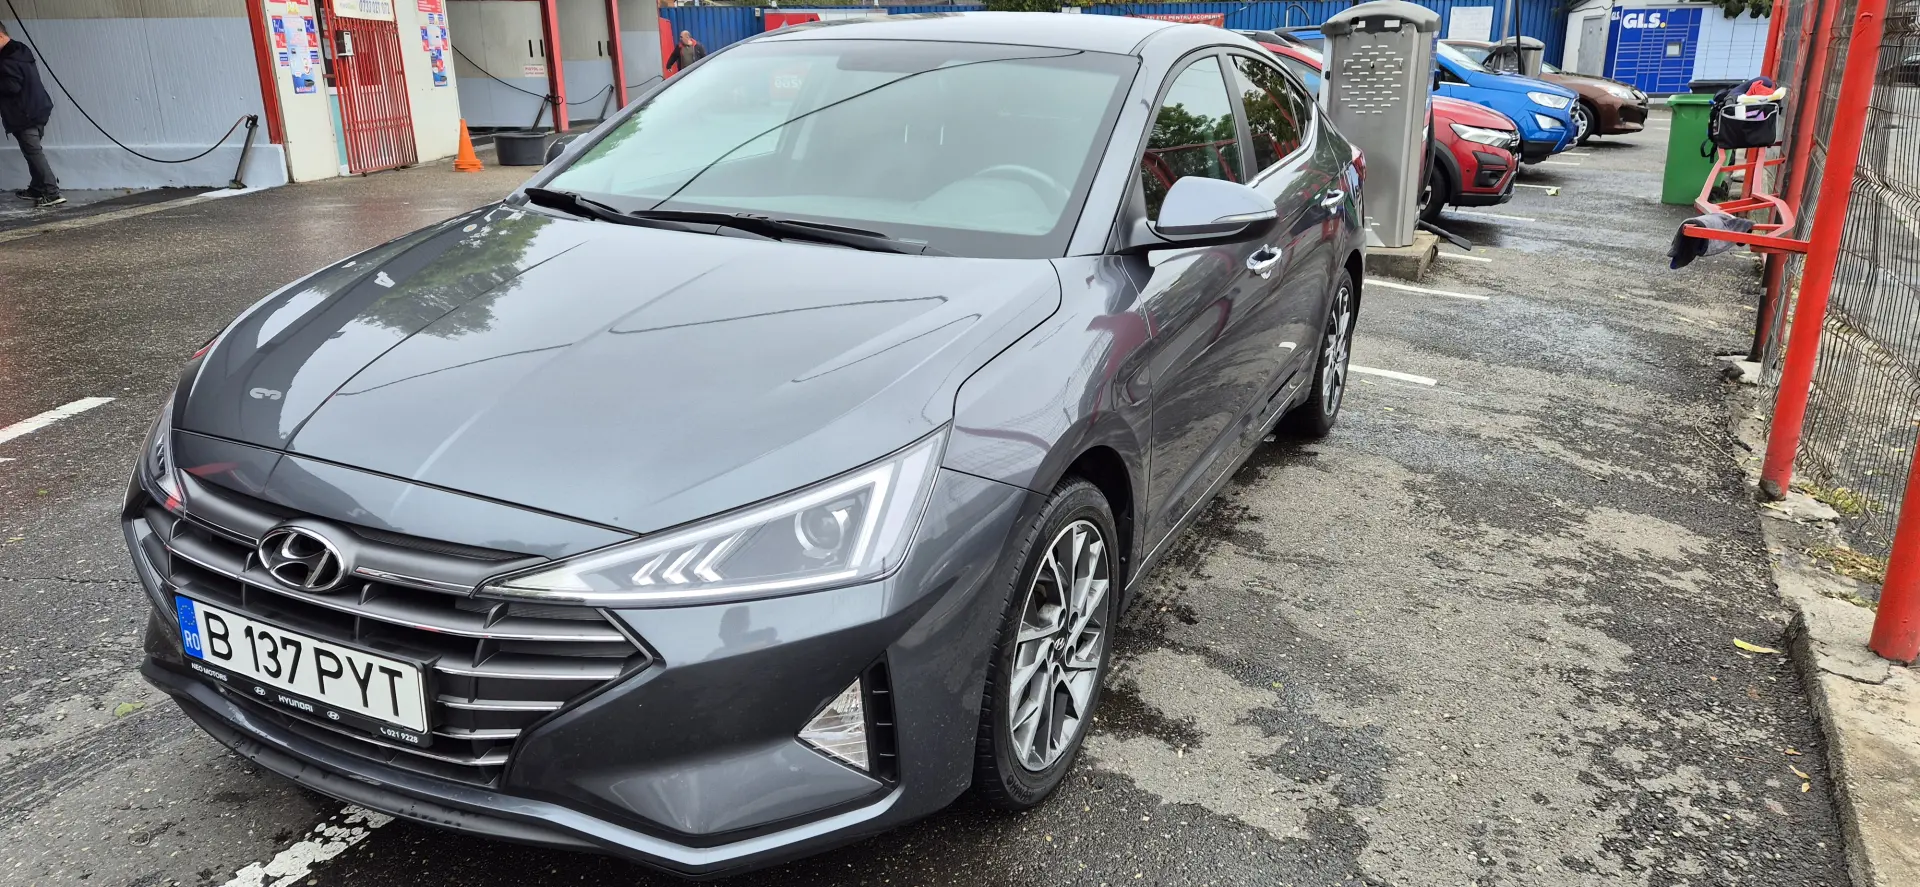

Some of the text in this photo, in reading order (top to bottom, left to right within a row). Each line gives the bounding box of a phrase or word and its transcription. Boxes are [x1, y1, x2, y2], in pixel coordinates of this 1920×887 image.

[184, 629, 200, 651] RO
[191, 662, 228, 682] NEO MOTORS
[203, 610, 403, 717] B 137 PYT
[278, 694, 314, 713] HYUNDAI
[387, 728, 418, 744] 021 9228
